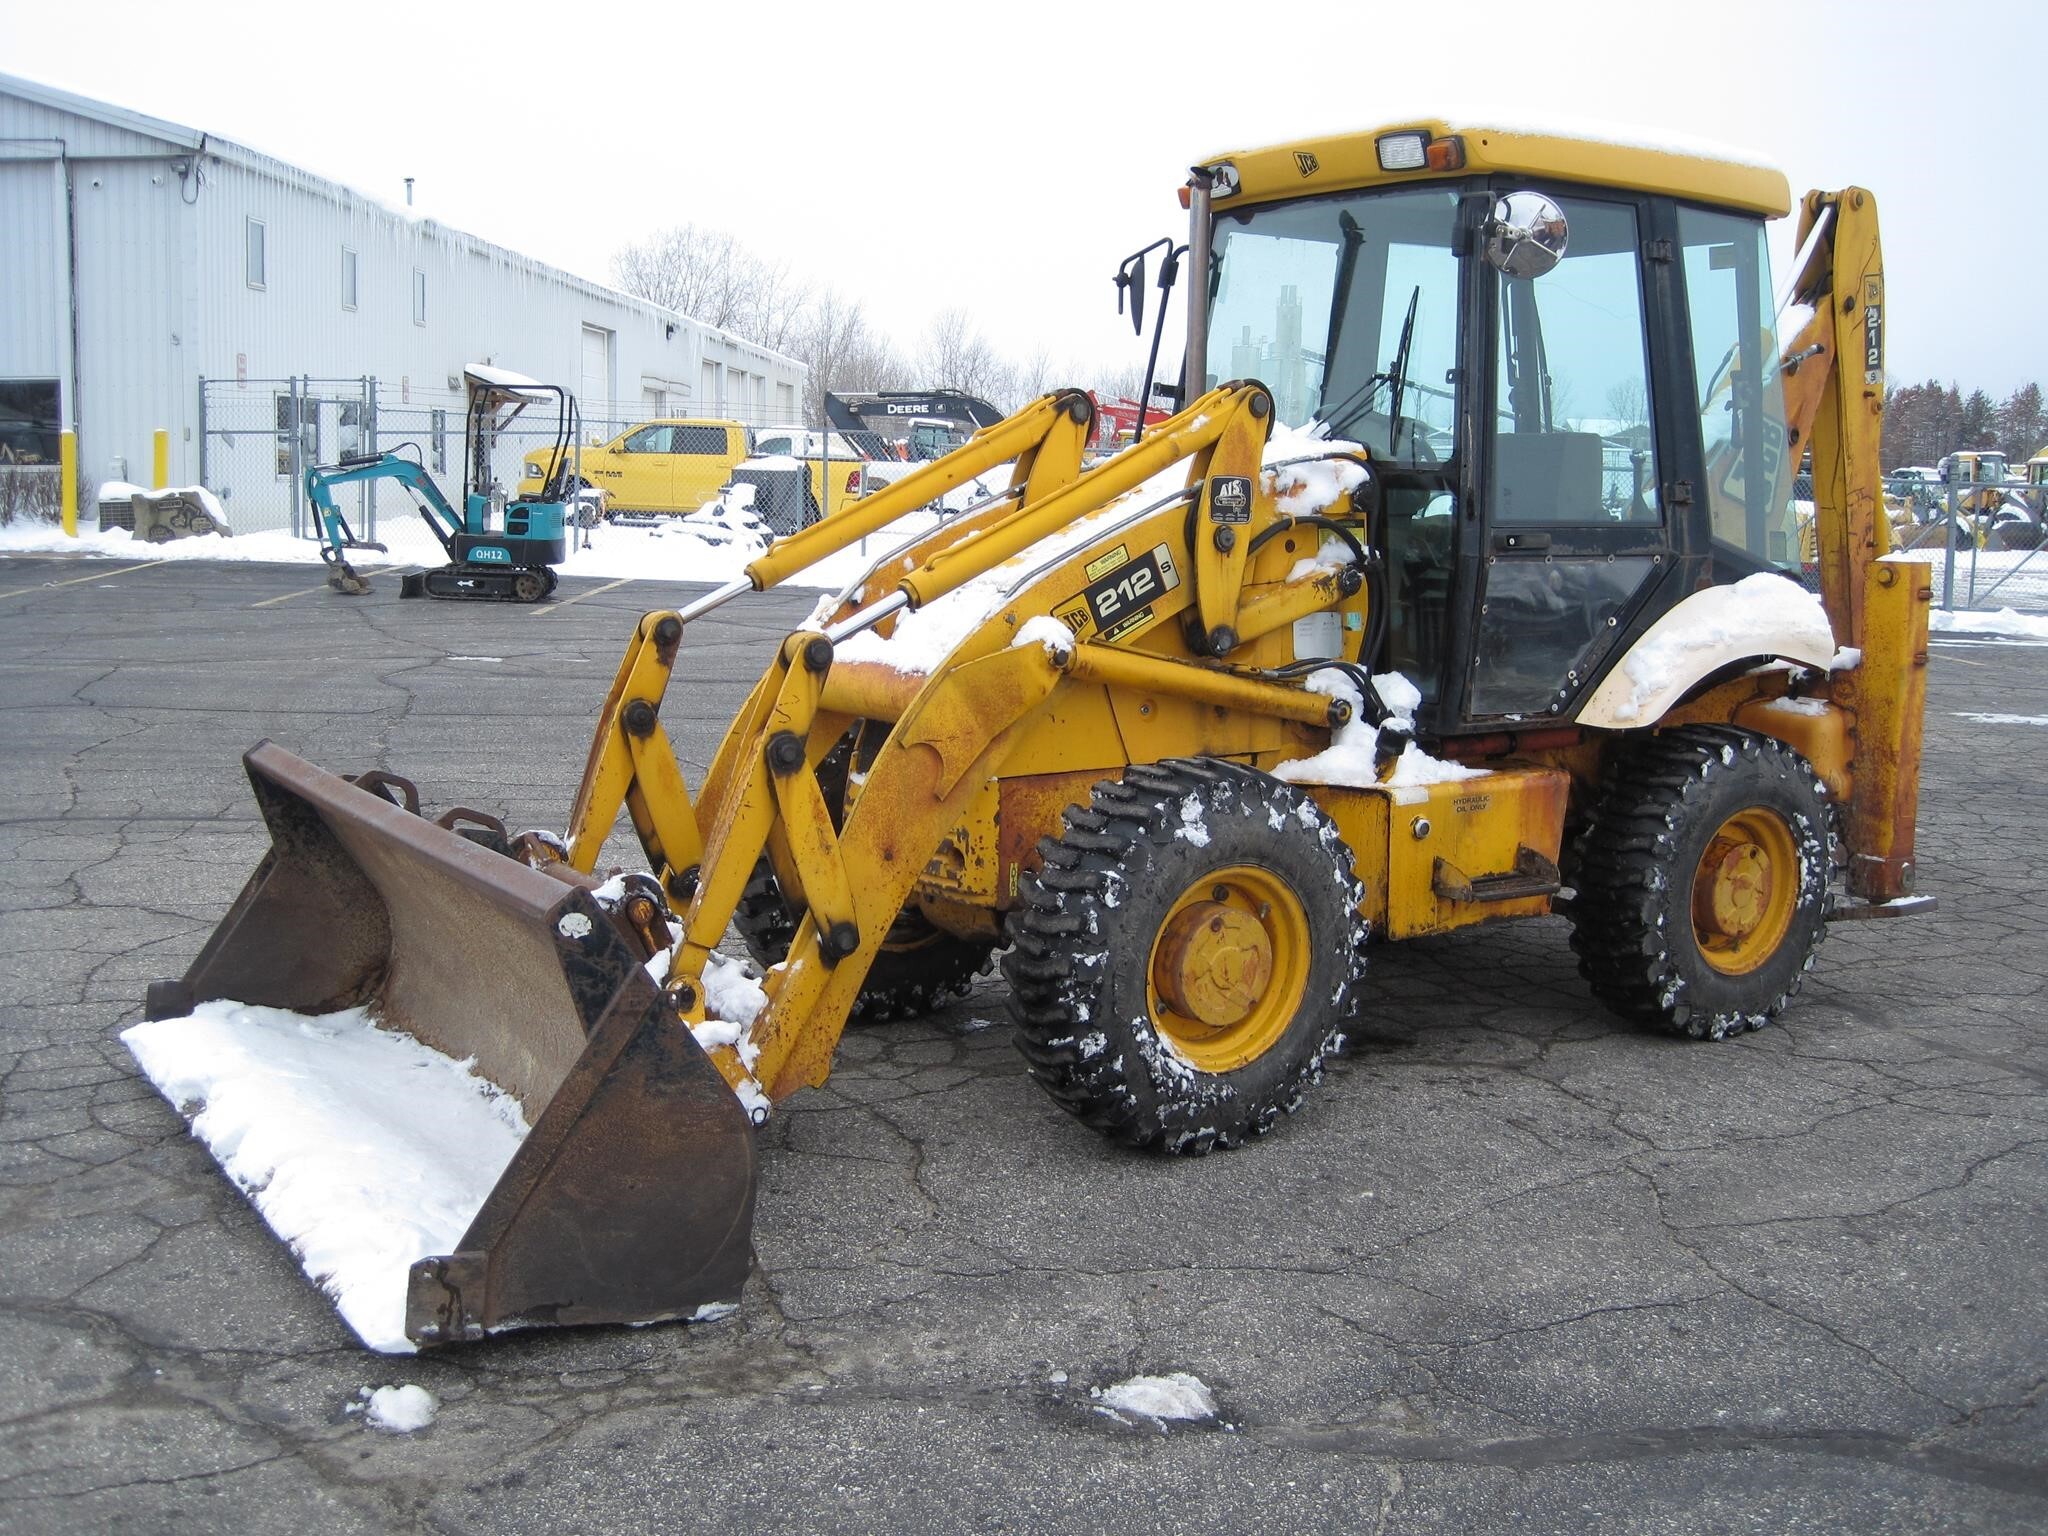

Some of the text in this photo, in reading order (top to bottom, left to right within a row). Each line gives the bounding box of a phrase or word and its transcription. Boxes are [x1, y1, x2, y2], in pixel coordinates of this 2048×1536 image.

[1297, 154, 1317, 175] JCB
[1865, 306, 1878, 365] 212
[887, 404, 929, 414] DEERE
[476, 550, 503, 560] QH12
[1062, 608, 1089, 635] JCB
[1095, 567, 1156, 618] 212
[1160, 561, 1172, 573] S
[1453, 795, 1490, 805] HYDRAULIC
